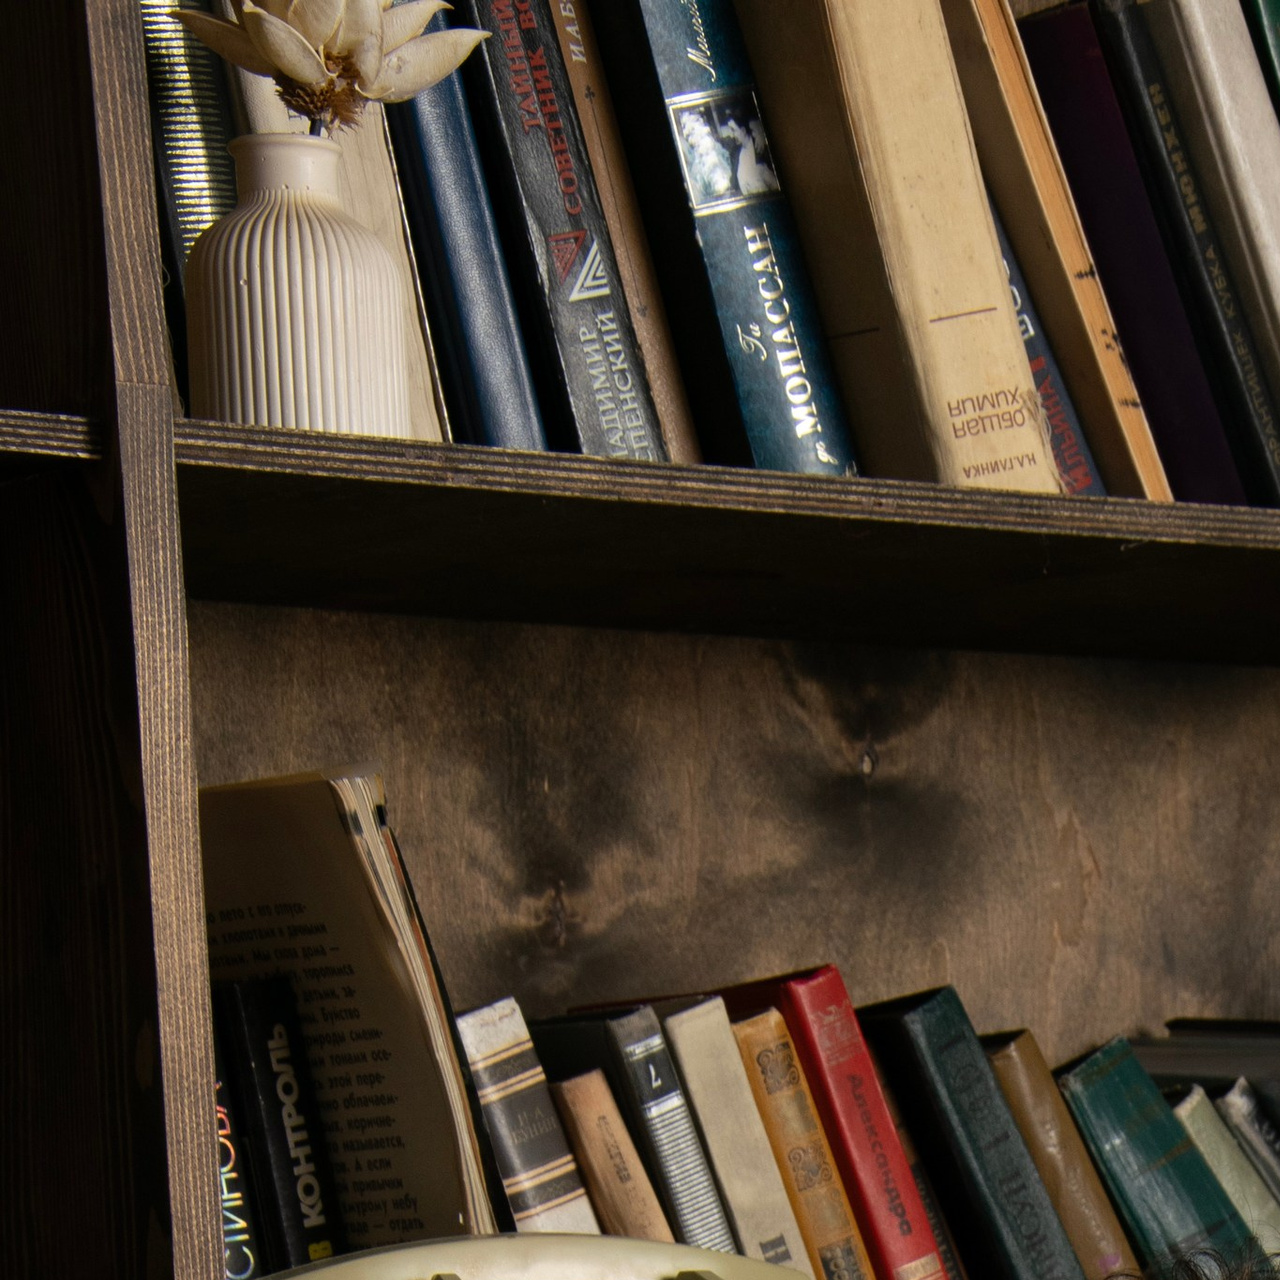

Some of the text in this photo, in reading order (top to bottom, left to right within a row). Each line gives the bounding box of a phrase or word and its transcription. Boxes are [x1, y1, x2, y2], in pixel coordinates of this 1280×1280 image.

[494, 0, 542, 134] ТАЙНЫЙ
[527, 47, 583, 216] СОВЕТНИК
[1149, 82, 1207, 233] МЮНХЕН
[742, 222, 823, 439] МОПАССАН
[1205, 244, 1236, 318] КУБКА
[947, 385, 1019, 417] ХИМИЯ
[951, 407, 1025, 438] ОБЩАЯ
[270, 1022, 328, 1229] КОНТРОЛЬ
[846, 1072, 912, 1239] Александра
